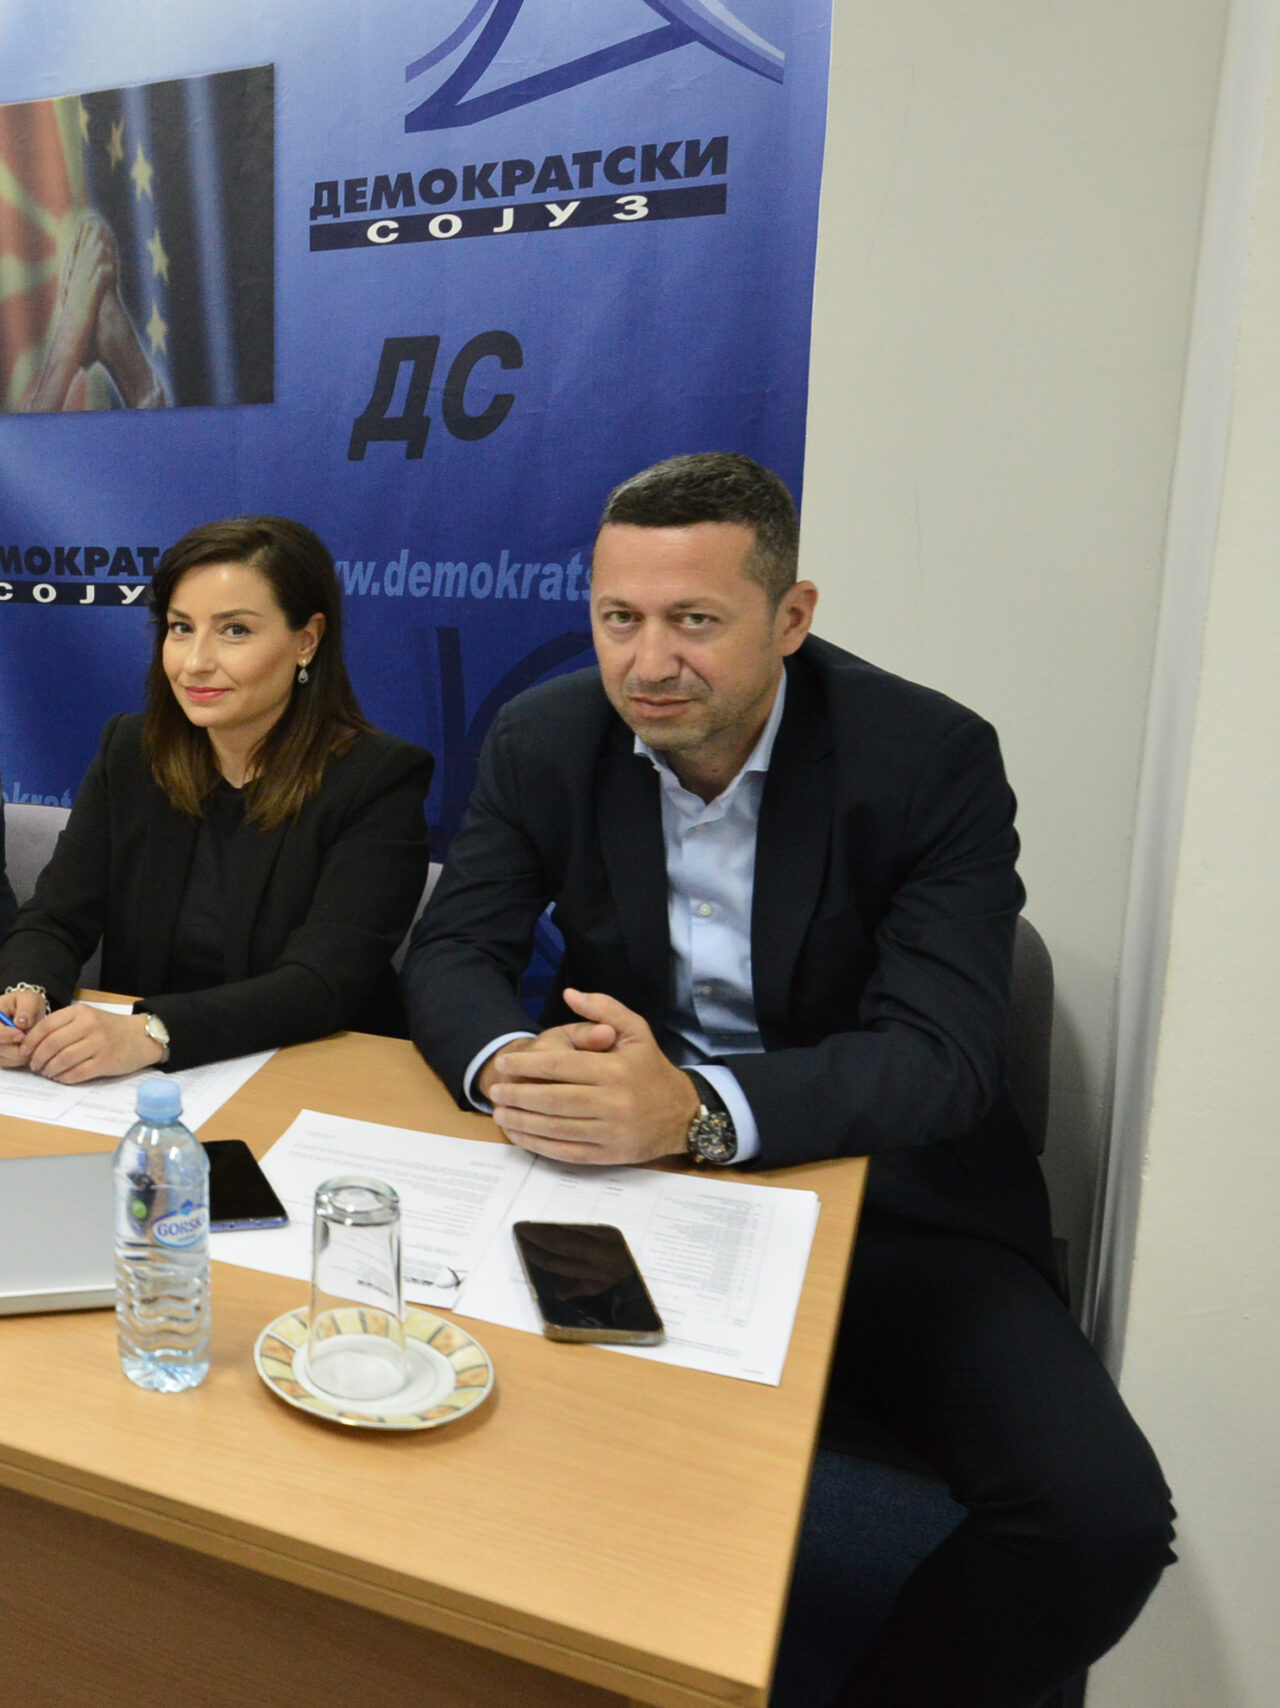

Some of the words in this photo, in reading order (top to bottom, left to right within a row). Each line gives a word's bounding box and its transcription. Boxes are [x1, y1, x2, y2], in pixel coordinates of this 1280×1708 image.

[309, 136, 729, 221] ДЕМОКРАТСКИ
[366, 195, 650, 244] СОЈУЗ
[346, 329, 524, 462] ДС
[157, 1216, 203, 1237] GORSK
